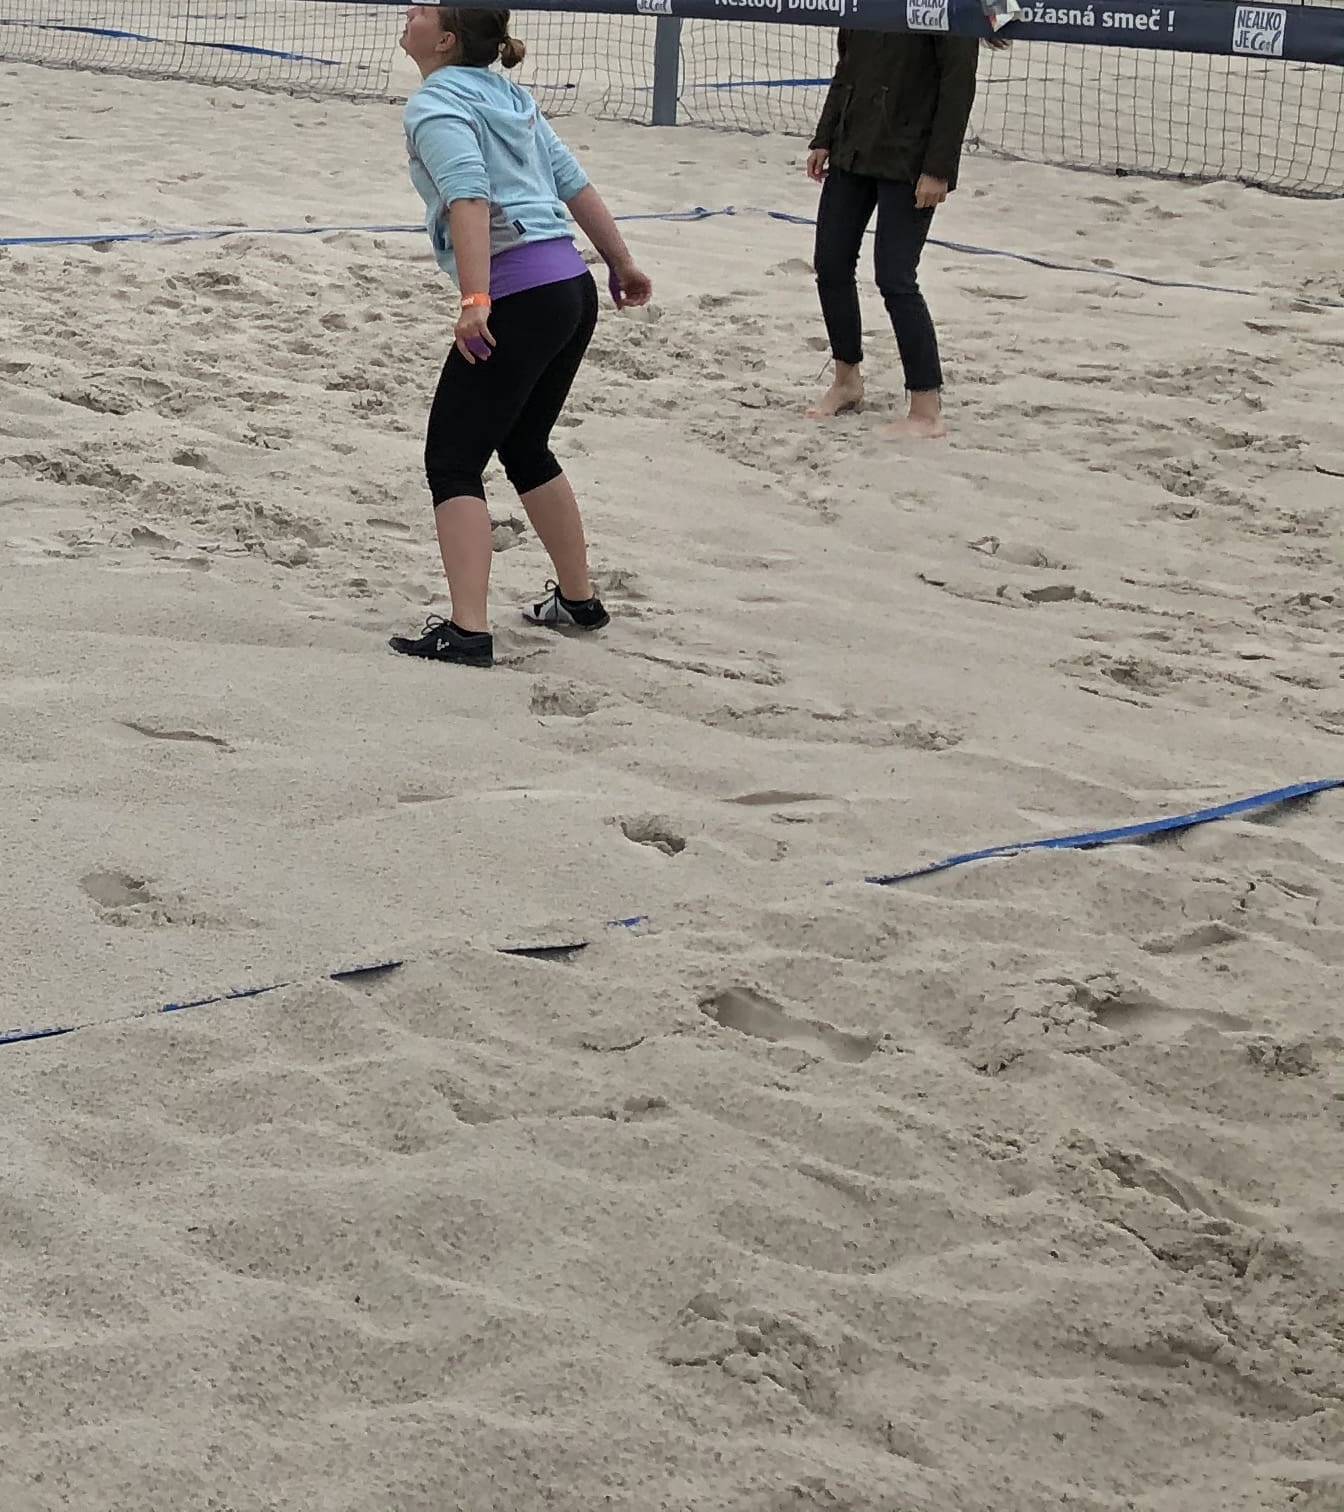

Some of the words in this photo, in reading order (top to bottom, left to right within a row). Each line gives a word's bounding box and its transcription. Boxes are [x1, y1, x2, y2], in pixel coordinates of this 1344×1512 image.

[908, 9, 922, 26] JE
[1021, 1, 1094, 27] ožasná
[1101, 9, 1161, 31] smeč
[1237, 10, 1282, 31] NEALKO
[1235, 30, 1250, 49] JE
